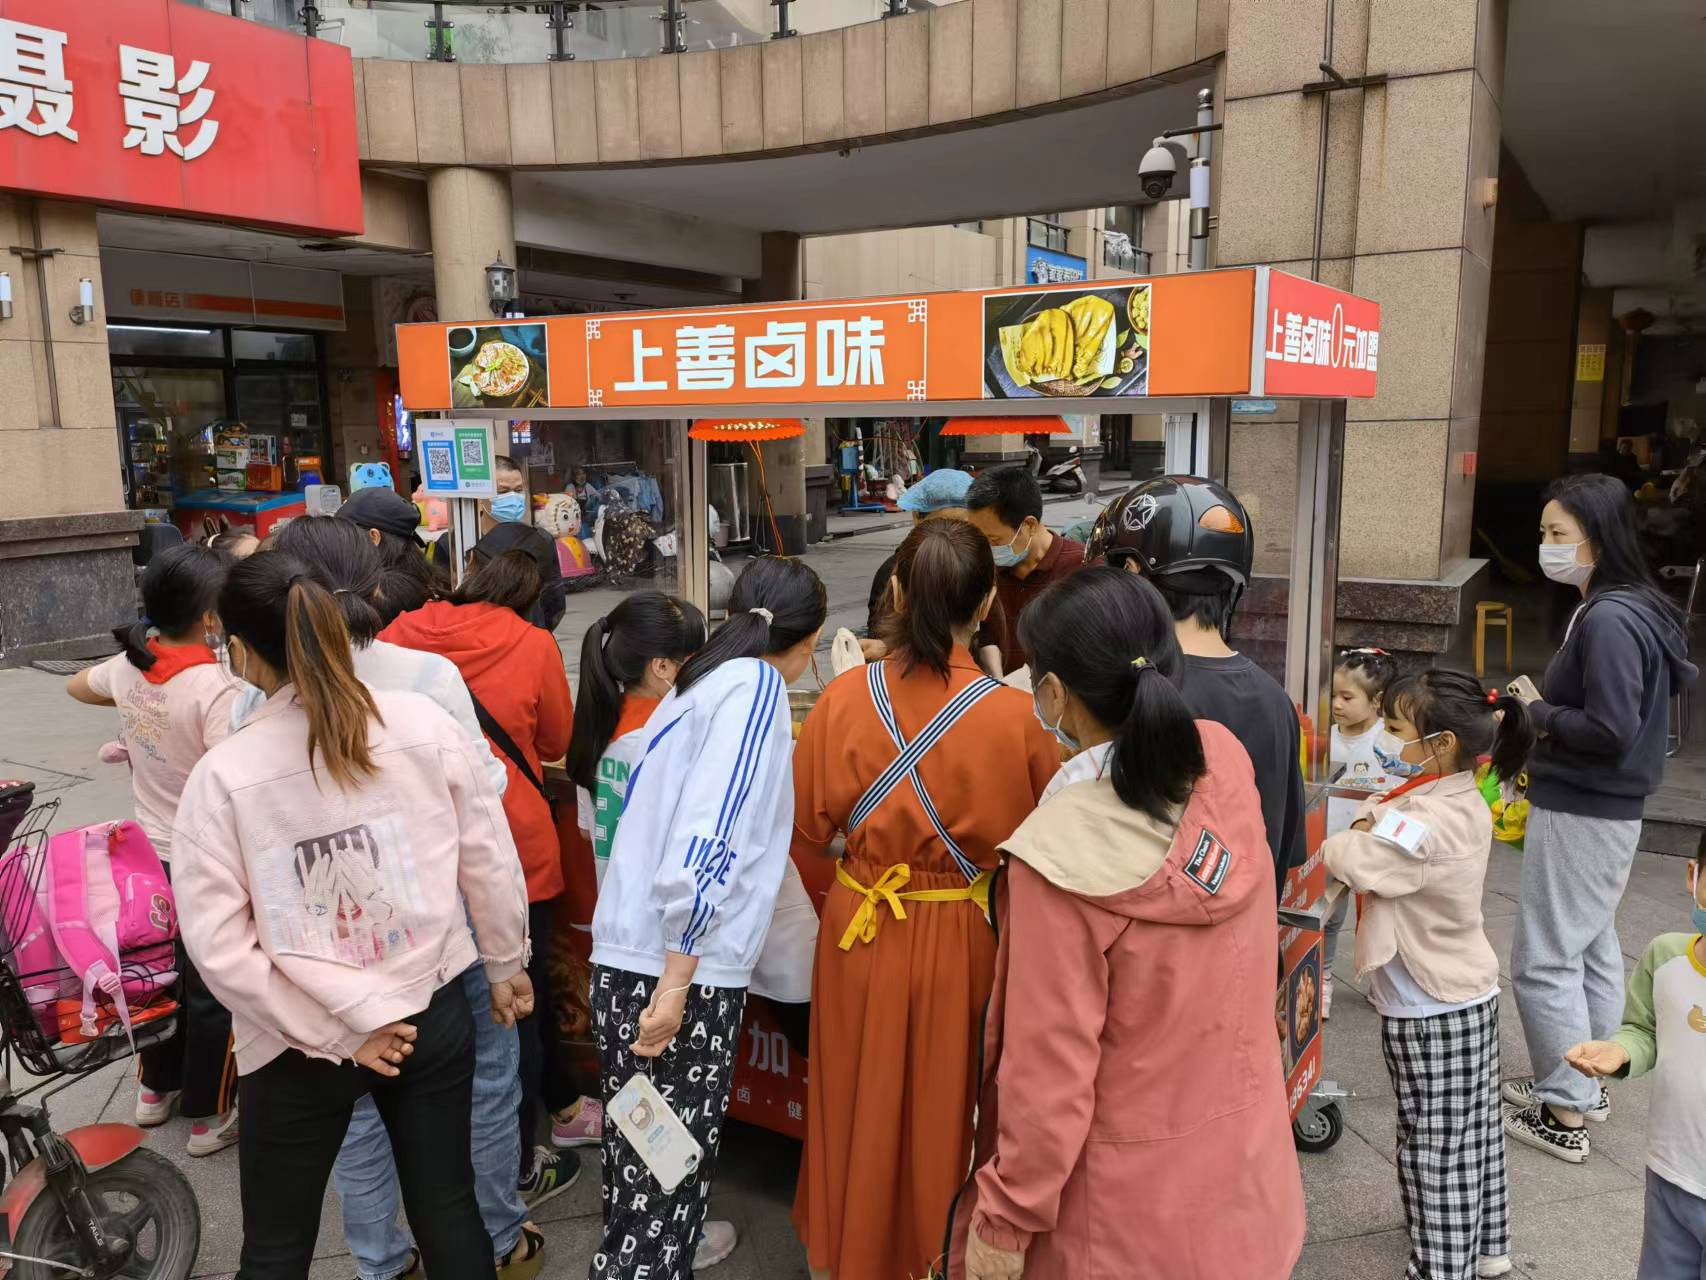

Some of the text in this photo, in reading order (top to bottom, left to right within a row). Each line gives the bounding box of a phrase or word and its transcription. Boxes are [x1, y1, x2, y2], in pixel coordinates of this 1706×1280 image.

[614, 316, 885, 391] 上善卤味
[600, 973, 610, 988] E
[632, 981, 646, 997] A
[612, 996, 620, 1012] L
[711, 1035, 722, 1051] R
[688, 1066, 702, 1082] C
[706, 1065, 719, 1081] Z
[704, 1099, 713, 1116] L
[632, 1194, 648, 1211] R
[673, 1204, 689, 1221] H
[648, 1220, 663, 1238] S
[622, 1235, 636, 1254] D
